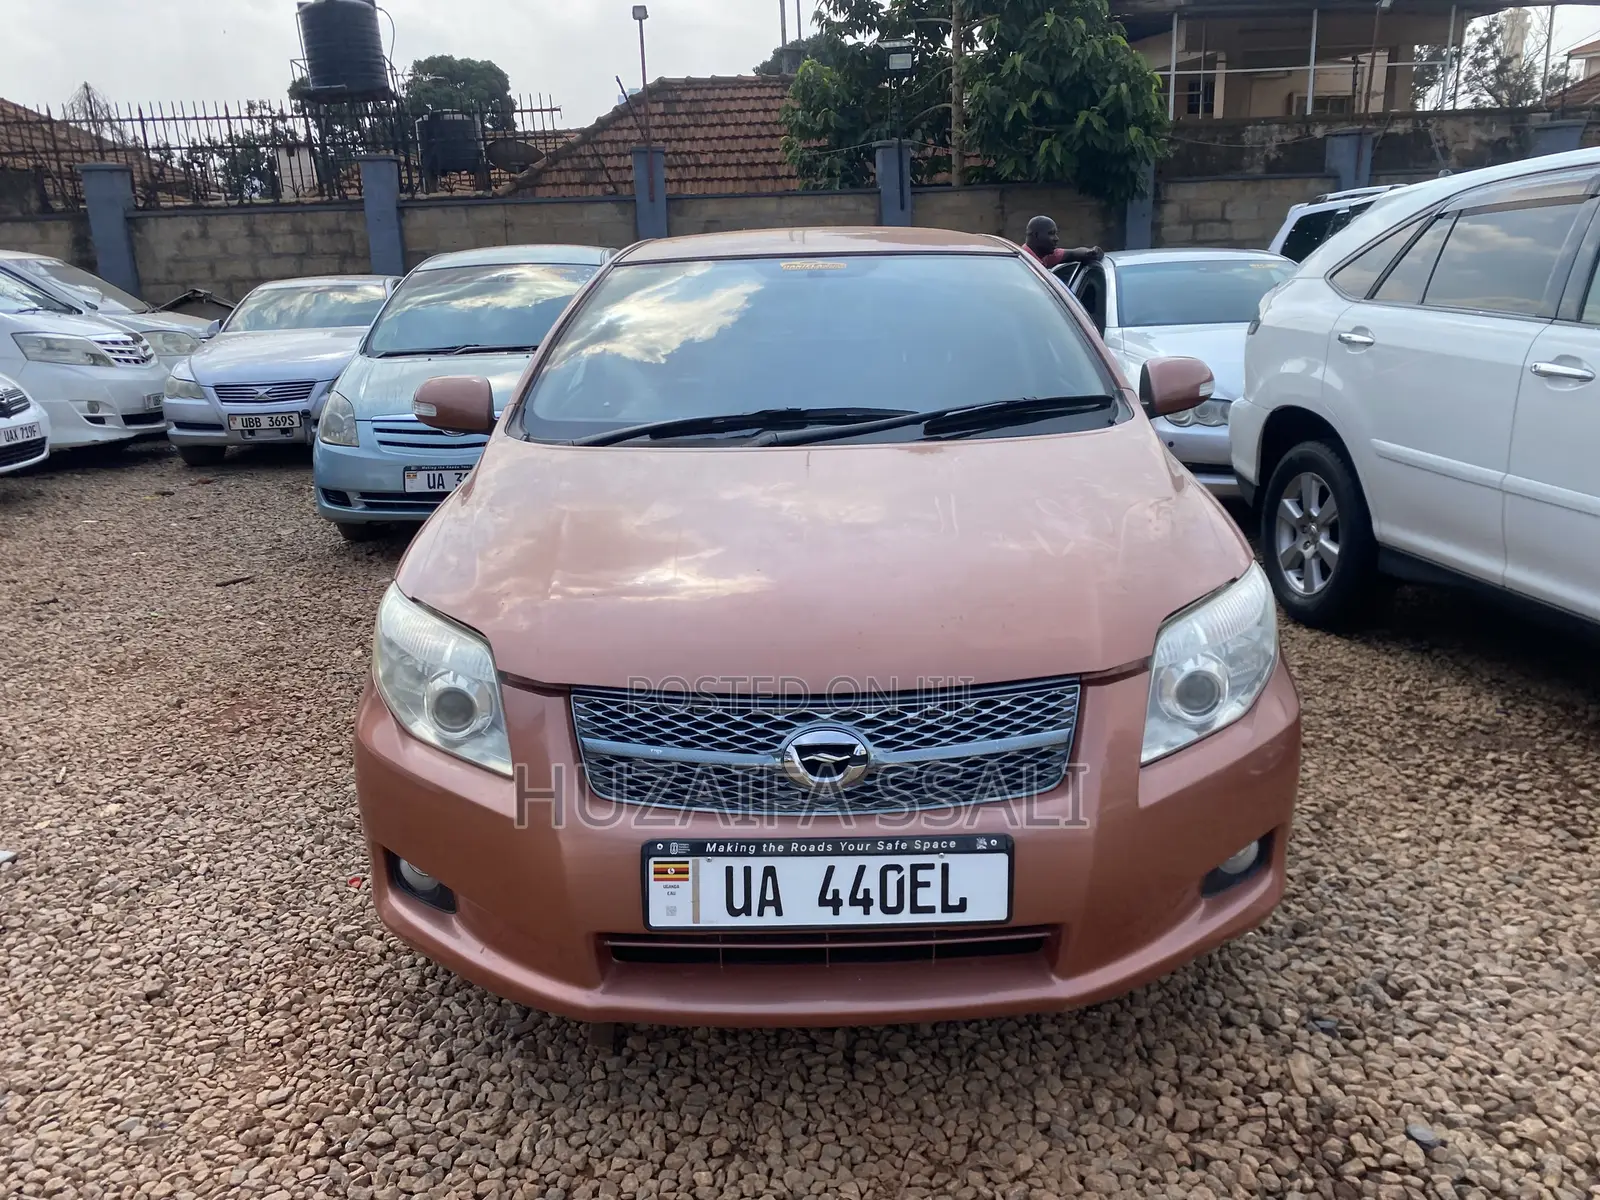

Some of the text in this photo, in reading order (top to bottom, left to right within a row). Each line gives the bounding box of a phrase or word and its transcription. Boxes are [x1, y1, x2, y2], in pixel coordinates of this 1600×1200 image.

[241, 415, 295, 428] UBB 369S
[4, 425, 37, 442] UAX 719F
[427, 473, 445, 489] UA
[705, 839, 956, 854] Making the Roads Your Safe Space
[725, 862, 967, 918] UA 440EL
